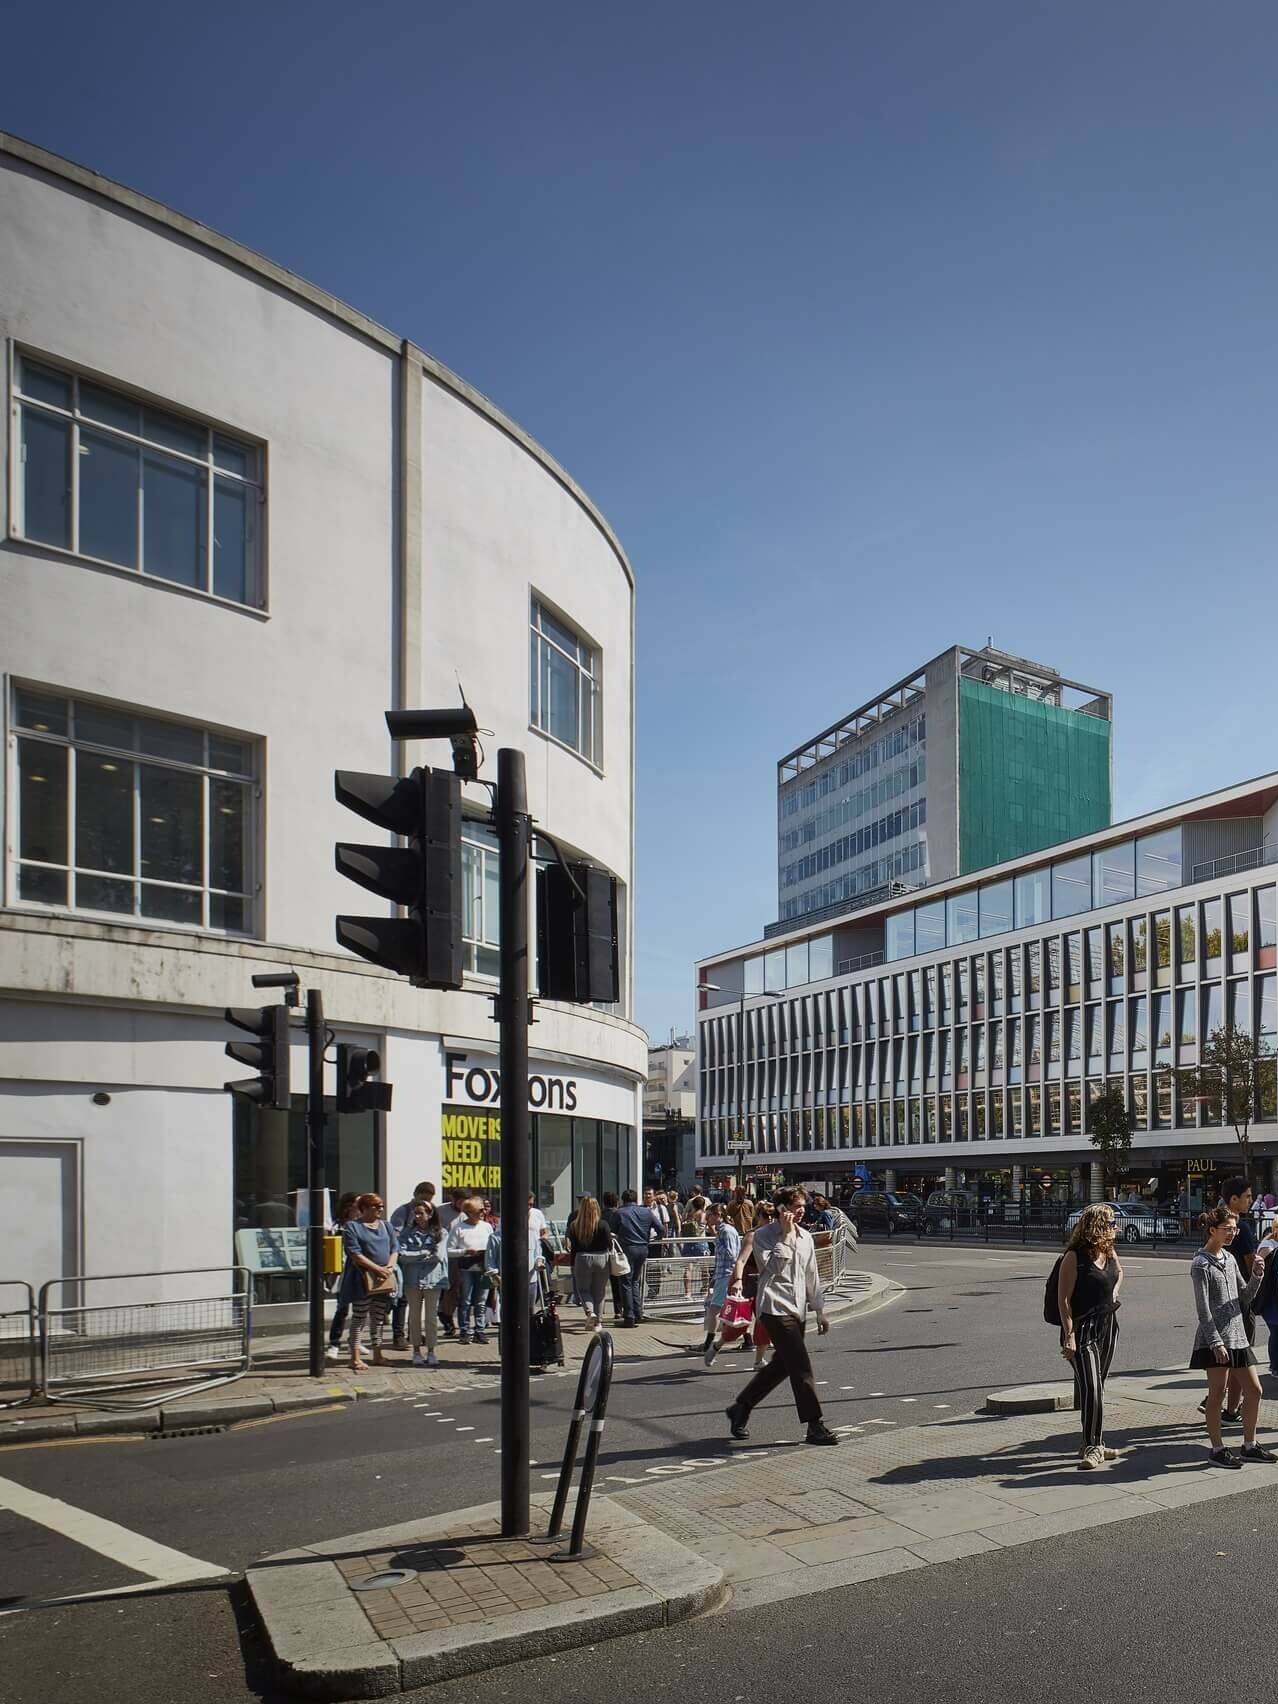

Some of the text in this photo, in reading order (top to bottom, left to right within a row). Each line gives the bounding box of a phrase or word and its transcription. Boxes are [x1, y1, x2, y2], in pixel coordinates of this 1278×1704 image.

[446, 1052, 577, 1111] Foxons
[442, 1141, 482, 1162] NEED
[442, 1165, 501, 1187] SHAKER
[1187, 1160, 1216, 1171] PAUL
